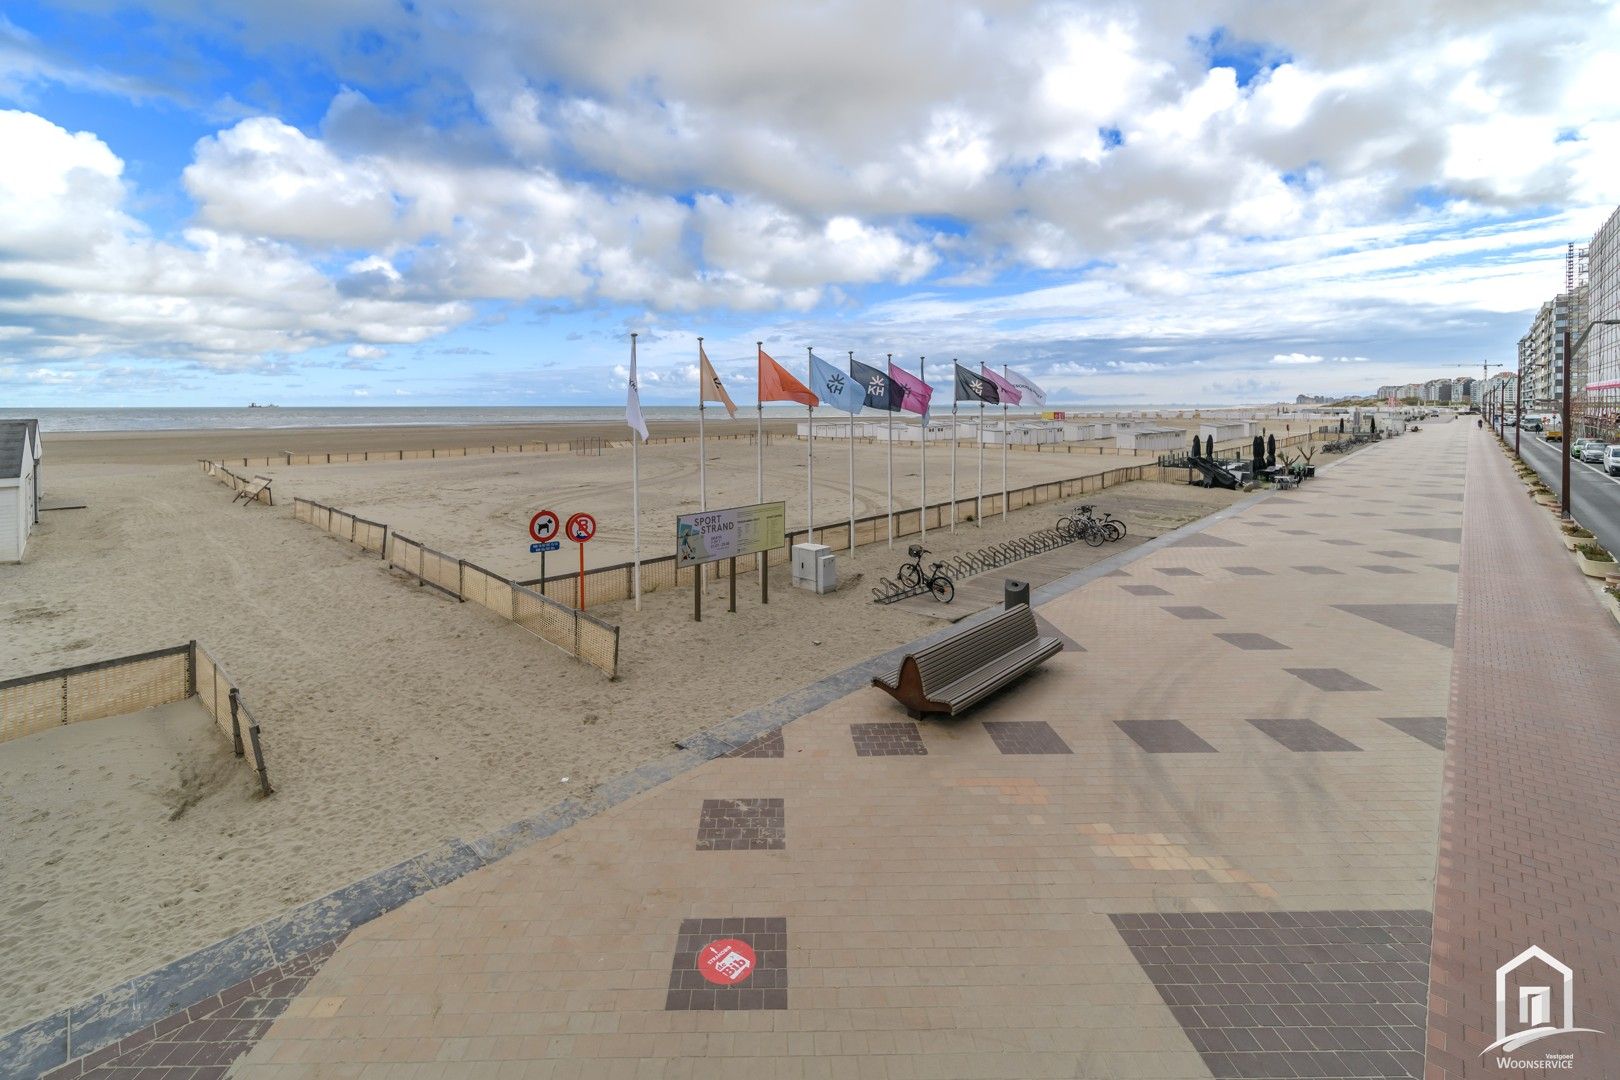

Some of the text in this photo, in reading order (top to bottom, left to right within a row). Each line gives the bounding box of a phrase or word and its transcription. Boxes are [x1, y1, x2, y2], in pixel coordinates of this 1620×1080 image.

[826, 382, 844, 395] KH
[867, 385, 885, 397] KH
[694, 515, 722, 527] SPORT
[701, 521, 735, 535] STRAND
[722, 959, 746, 976] Bib
